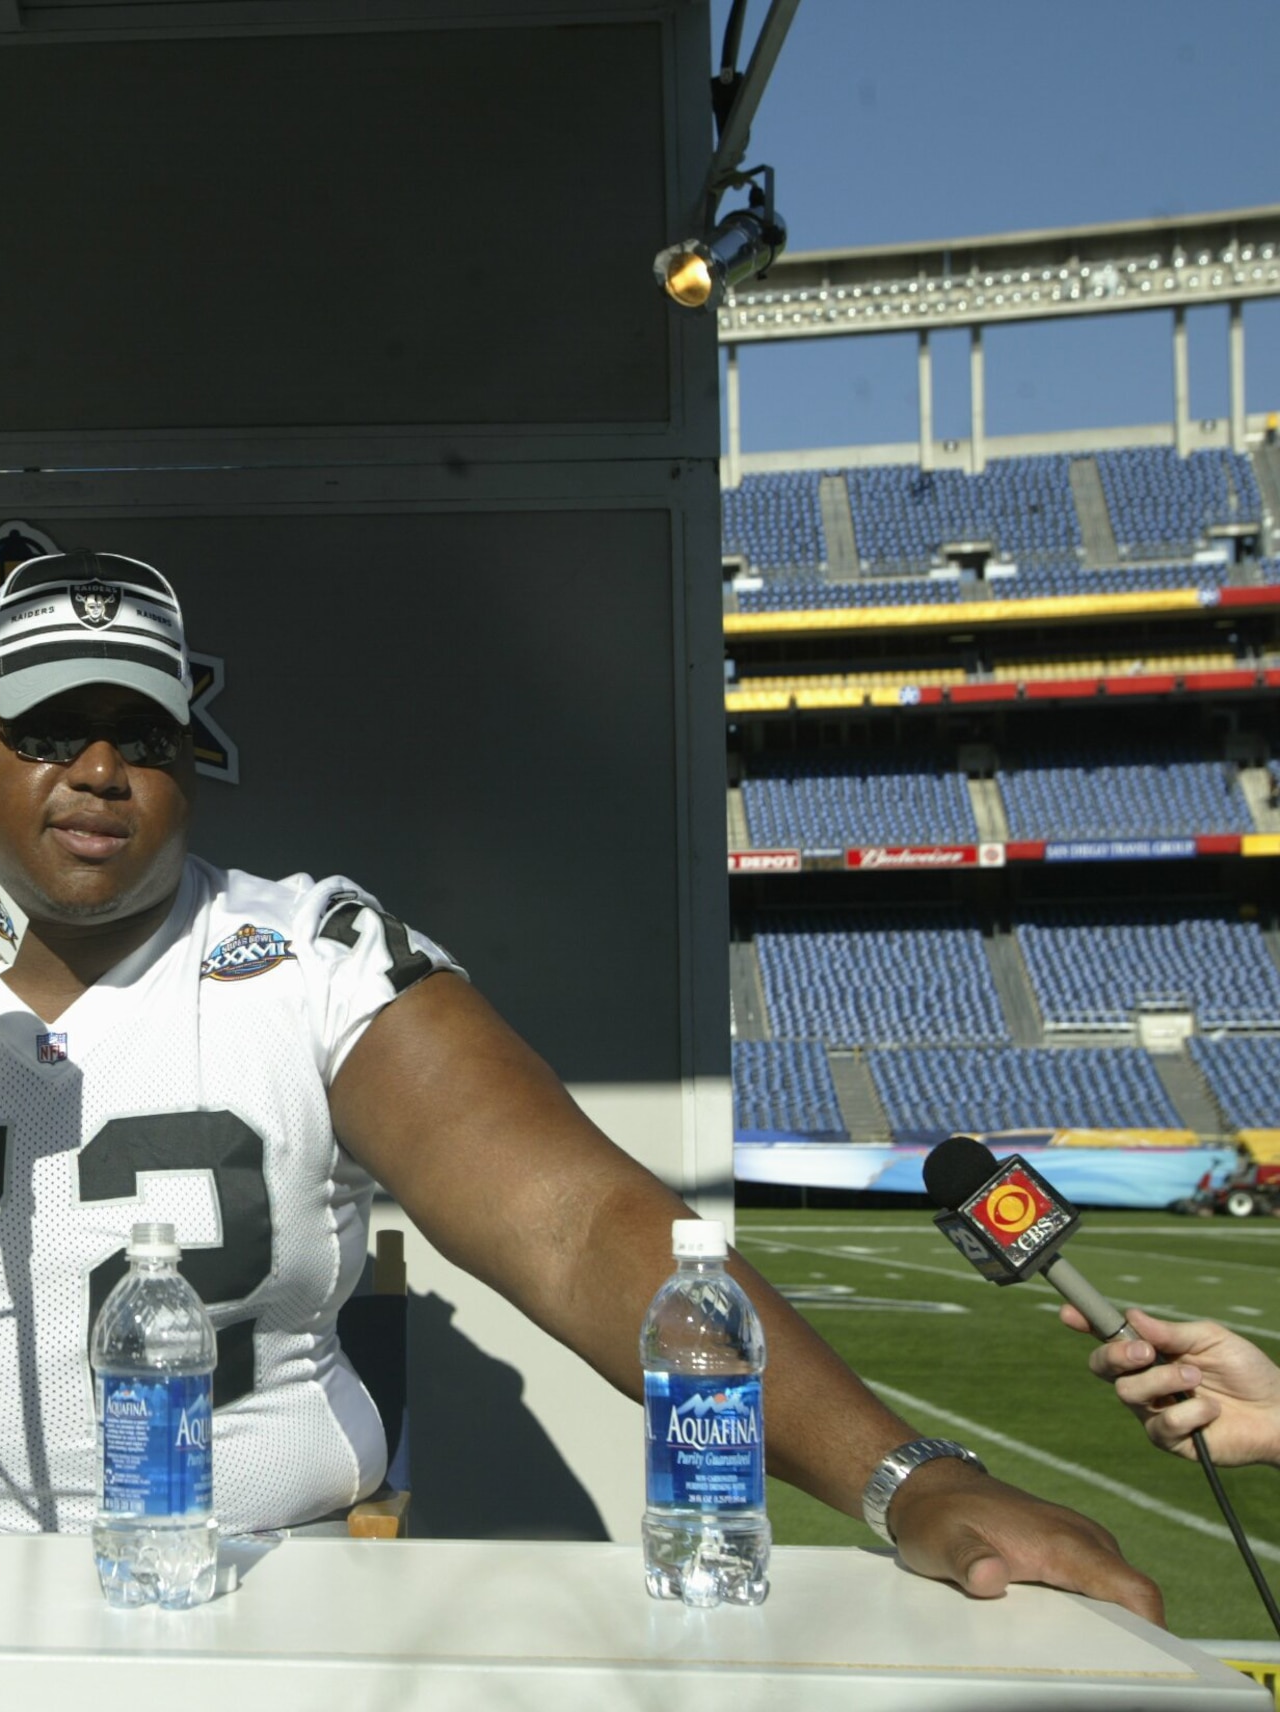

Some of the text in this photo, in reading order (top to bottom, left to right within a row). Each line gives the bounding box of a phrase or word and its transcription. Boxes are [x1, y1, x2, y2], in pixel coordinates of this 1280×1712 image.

[73, 584, 118, 594] RAIDERS
[11, 605, 56, 623] RAIDERS
[135, 609, 172, 628] RAIDERS
[740, 855, 799, 871] DEPOT
[860, 847, 964, 868] Budweiser
[40, 1044, 66, 1061] NFL
[1017, 1216, 1055, 1251] CBS
[106, 1395, 148, 1418] AQUAFINA
[666, 1405, 759, 1451] AQUAFINA
[677, 1450, 704, 1469] Purity
